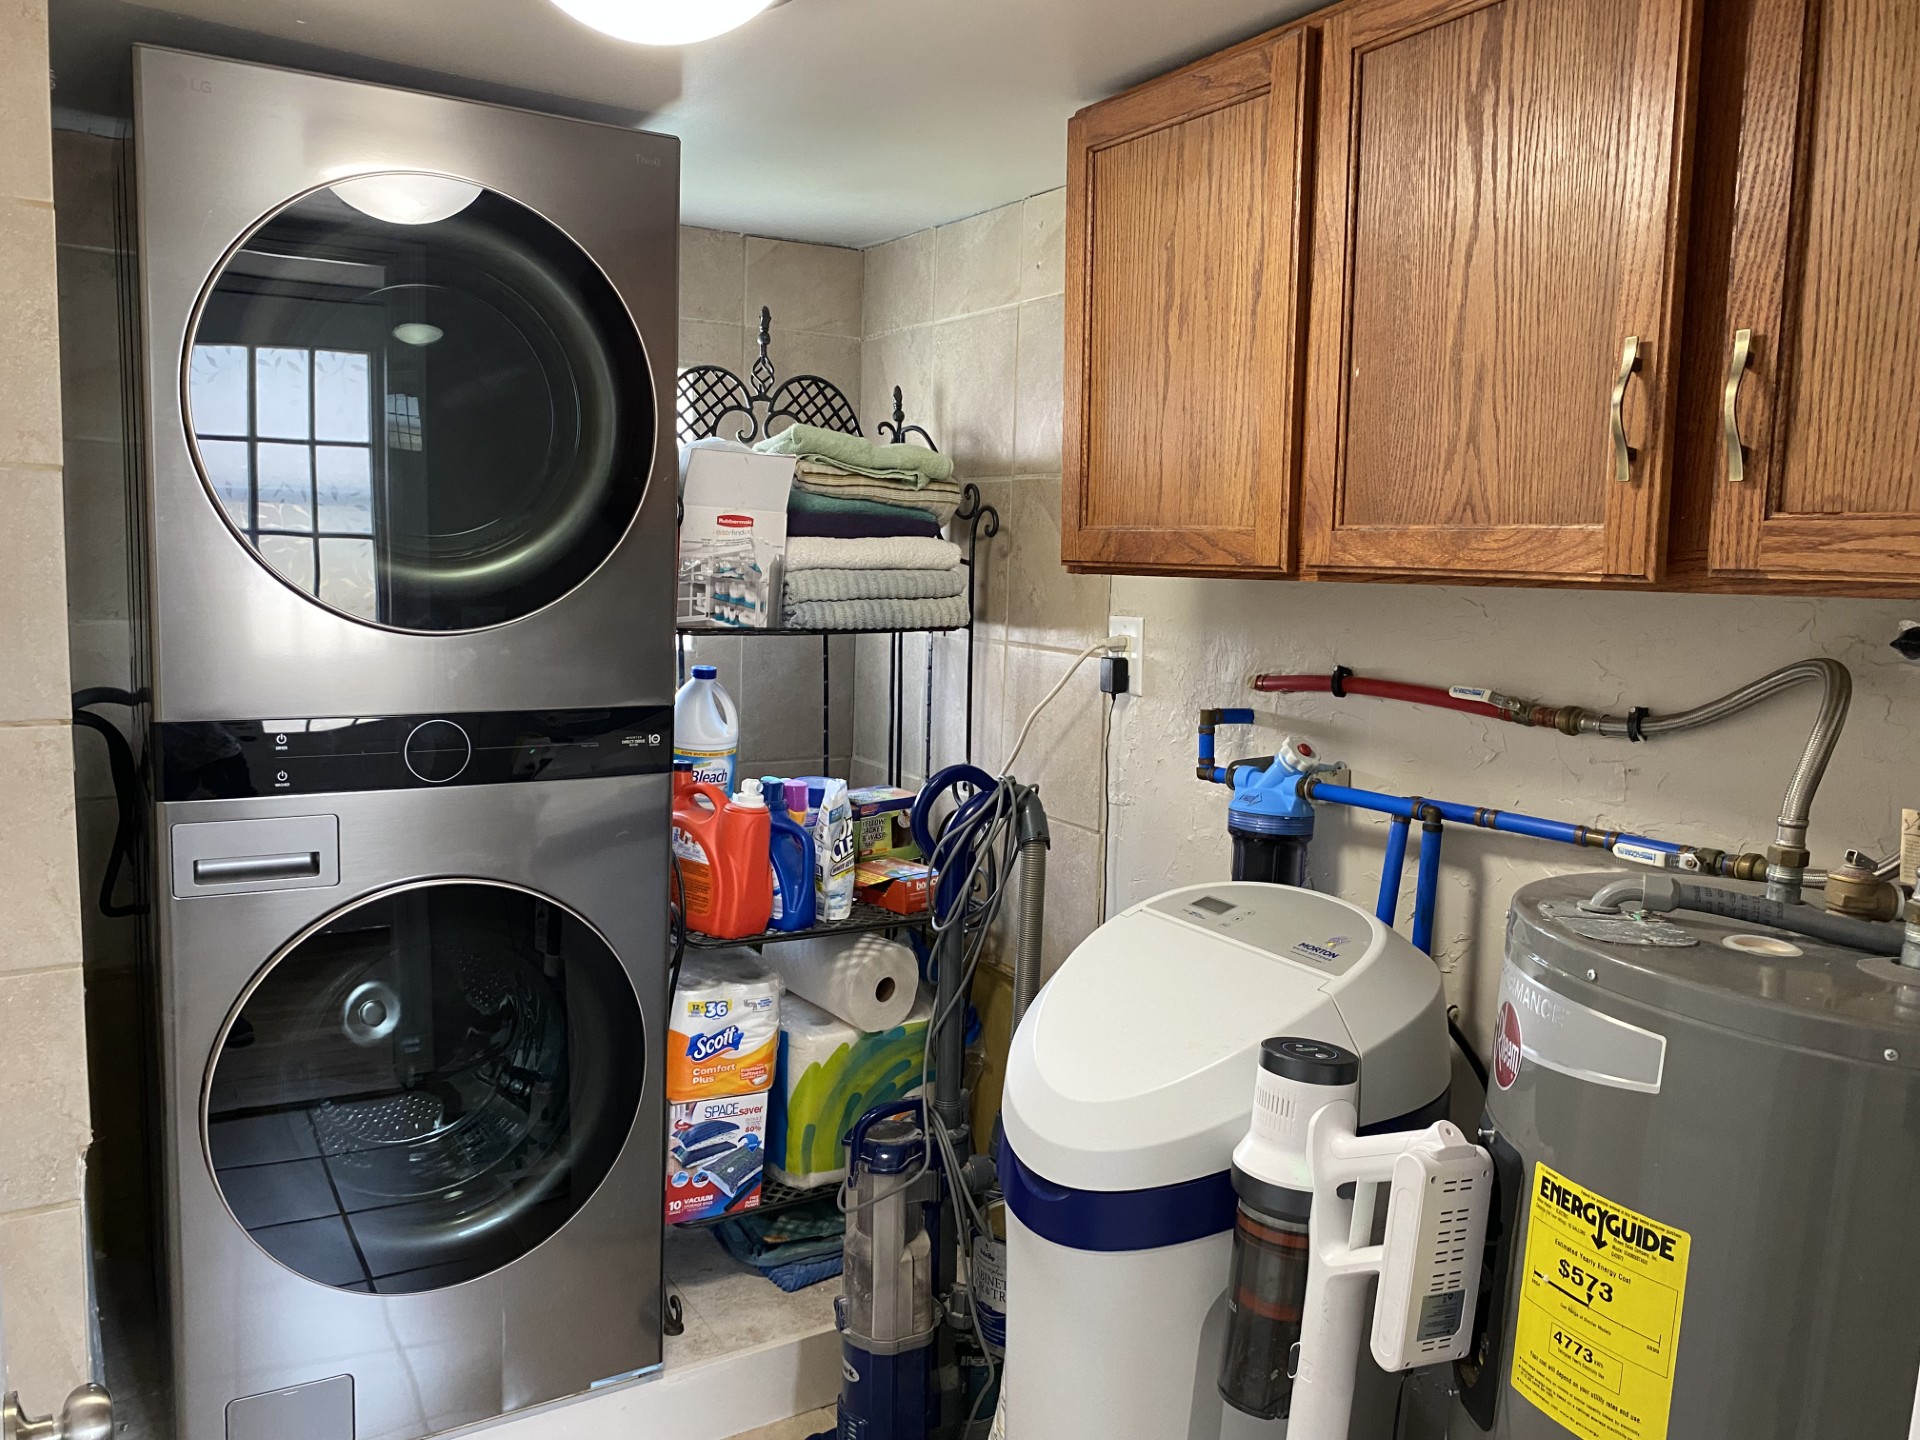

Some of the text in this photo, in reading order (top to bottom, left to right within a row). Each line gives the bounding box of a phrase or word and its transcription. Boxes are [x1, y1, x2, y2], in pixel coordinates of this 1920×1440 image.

[191, 78, 212, 93] LG
[692, 769, 727, 783] Bleach
[1298, 942, 1340, 959] MORTON
[705, 1002, 728, 1018] 36
[694, 1026, 736, 1059] Scott
[693, 1064, 736, 1076] Comfort
[693, 1076, 714, 1084] Plus
[705, 1103, 763, 1118] SPACE saver
[669, 1201, 681, 1210] 10
[684, 1195, 713, 1204] VACUUM
[1540, 1176, 1676, 1262] ENERGYGUIDE
[1555, 1238, 1578, 1258] Estimated
[1579, 1250, 1596, 1269] Yearly
[1598, 1260, 1621, 1280] Energy
[1618, 1272, 1631, 1286] Cost
[1558, 1258, 1614, 1304] $573
[1553, 1330, 1593, 1364] 4773
[1555, 1369, 1571, 1385] depend
[1579, 1385, 1590, 1395] your
[1590, 1391, 1604, 1405] utility
